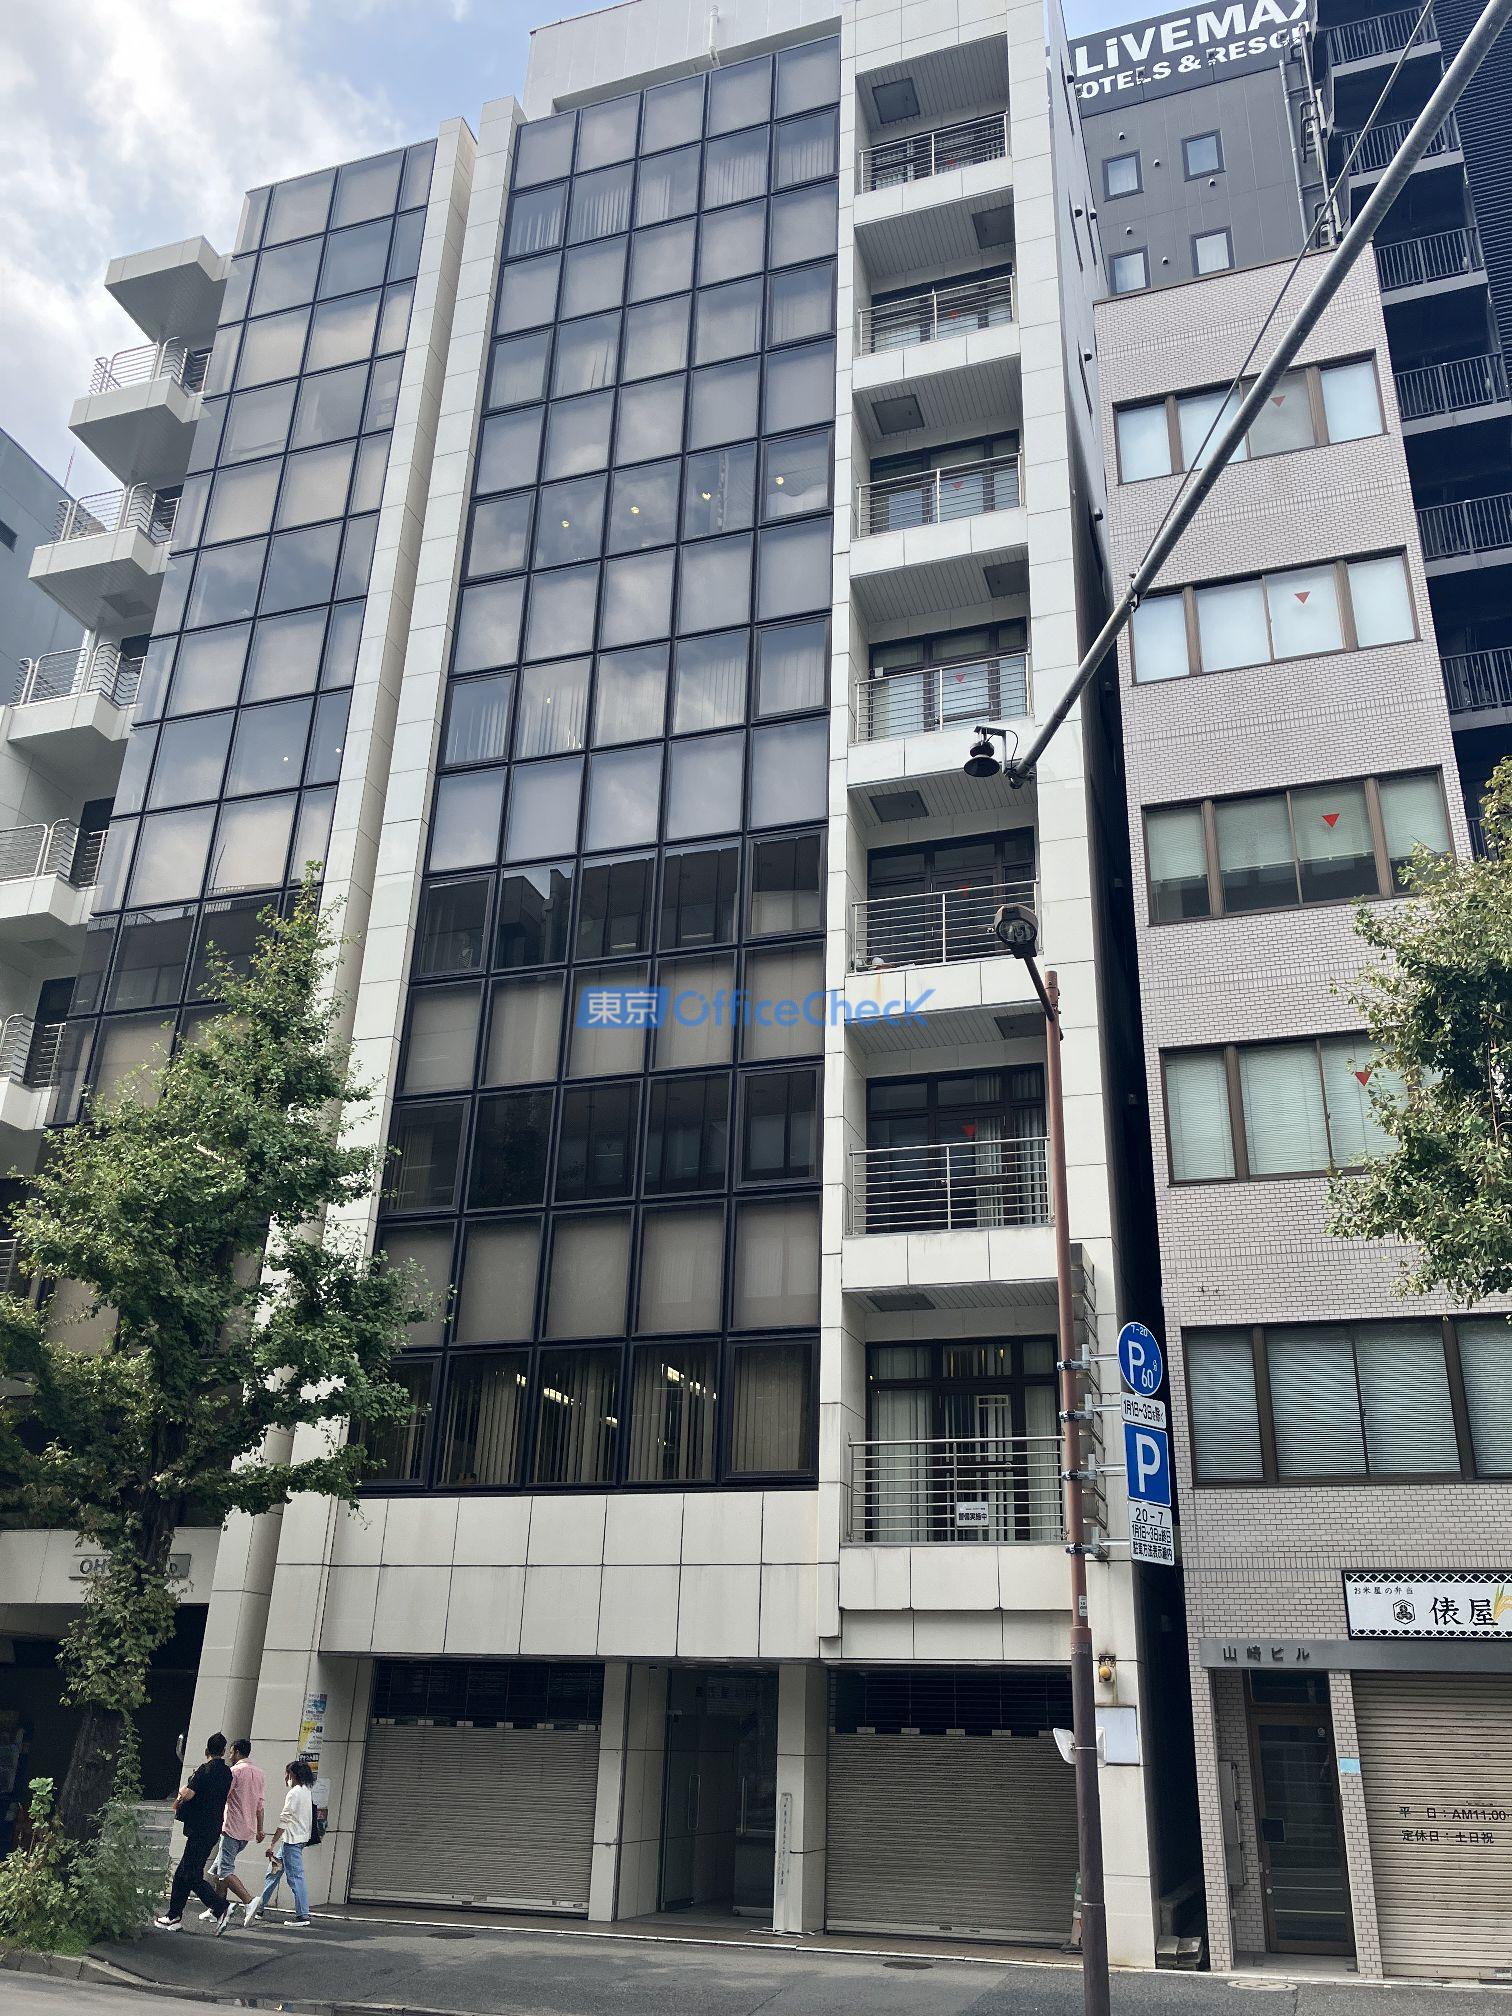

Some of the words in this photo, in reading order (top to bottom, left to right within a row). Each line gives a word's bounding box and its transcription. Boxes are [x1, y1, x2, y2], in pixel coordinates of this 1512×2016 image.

[1080, 62, 1171, 99] OTELS
[1178, 55, 1201, 73] &
[1130, 1324, 1148, 1337] 7-20
[1127, 1340, 1145, 1384] P
[1136, 1433, 1161, 1492] P
[1353, 1586, 1414, 1595] お米屋の弁当
[1428, 1596, 1498, 1627] 俵屋
